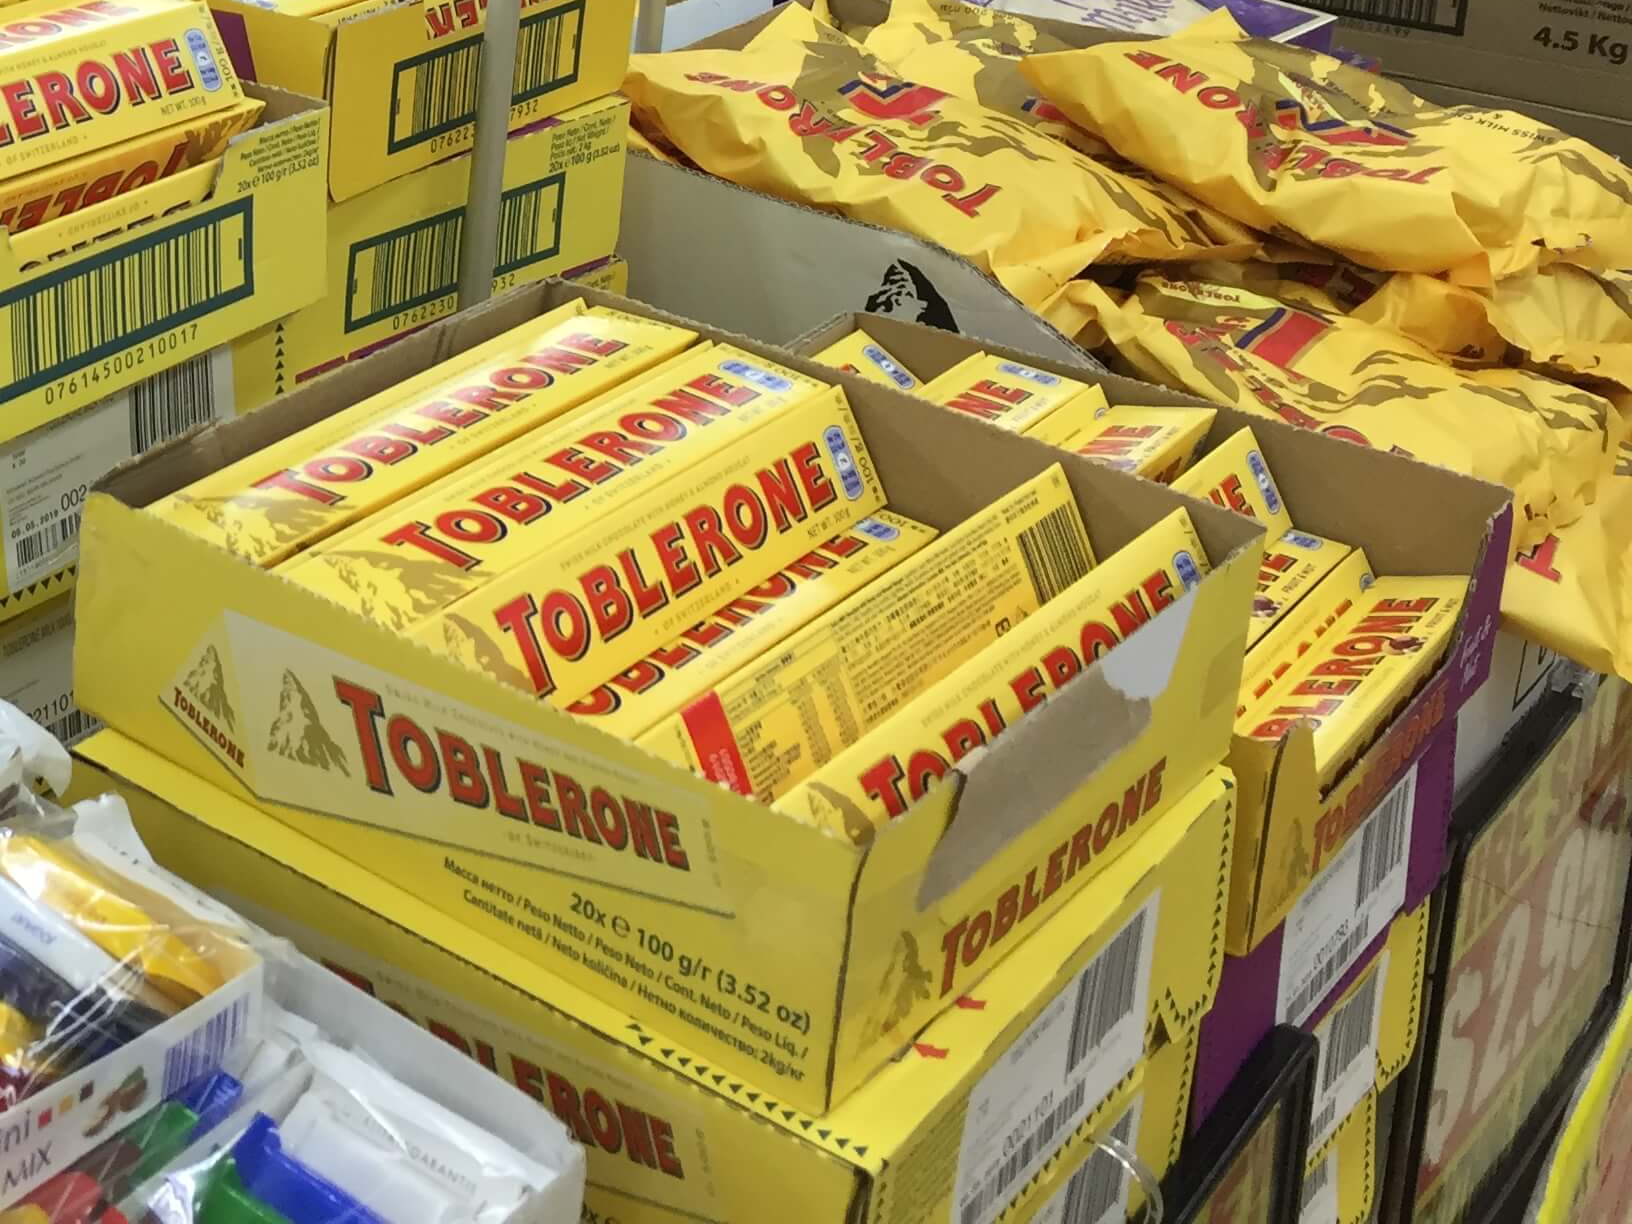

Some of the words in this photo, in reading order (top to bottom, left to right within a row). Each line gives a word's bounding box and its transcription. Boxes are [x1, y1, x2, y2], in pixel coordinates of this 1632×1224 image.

[1532, 25, 1580, 53] 4.5
[1587, 32, 1630, 66] Kg
[19, 136, 79, 162] SWITZERLAND
[44, 322, 200, 406] 07614500210017
[254, 329, 628, 509] TOBLERONE
[386, 372, 762, 574] TOBLERONE
[493, 439, 838, 697] TOBLERONE
[172, 686, 246, 770] TOBLERONE
[1249, 596, 1441, 742] BLERONE
[333, 675, 693, 872] TOBLERONE
[551, 934, 582, 962] Neto
[939, 756, 1167, 998] TOBLERONE
[522, 897, 551, 924] Peso
[552, 912, 586, 943] Netto
[594, 932, 624, 962] Peso
[624, 951, 656, 979] Neto
[699, 991, 732, 1021] Neto
[739, 1015, 773, 1043] Peso
[569, 891, 608, 928] 20x
[636, 927, 675, 963] 100
[716, 968, 772, 1014] (3.52
[775, 1004, 812, 1036] oz)
[0, 1141, 55, 1195] MIX
